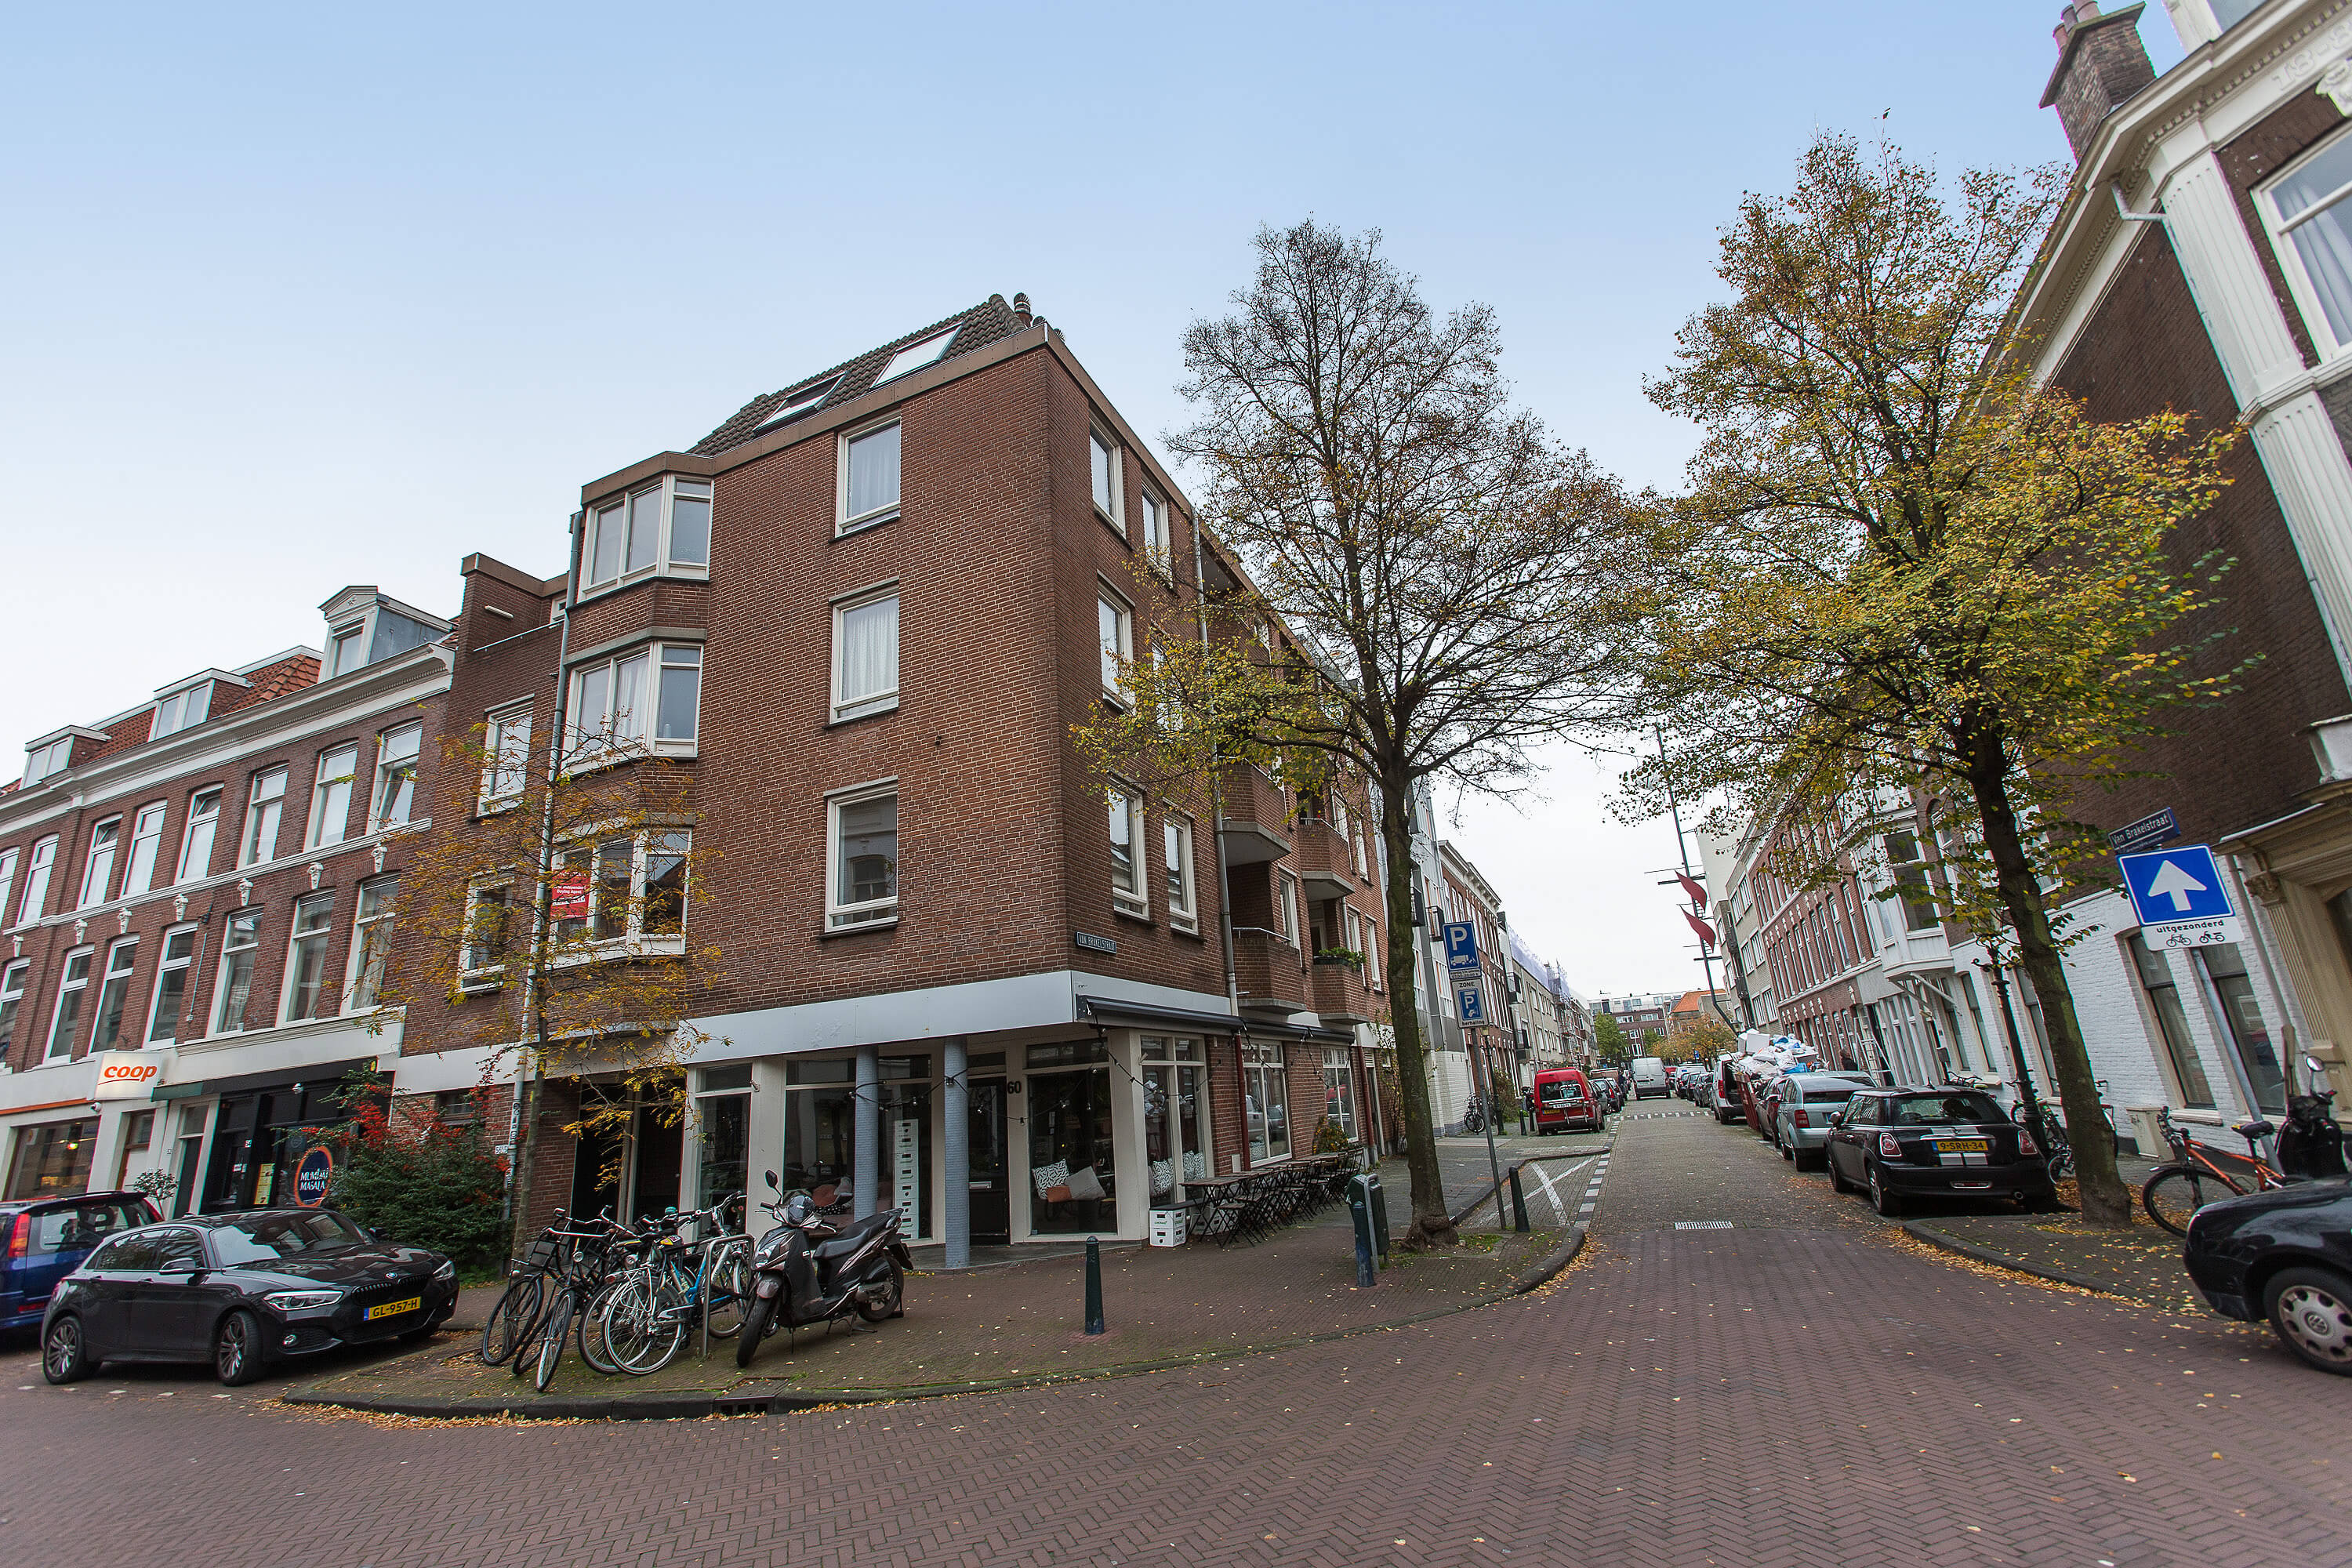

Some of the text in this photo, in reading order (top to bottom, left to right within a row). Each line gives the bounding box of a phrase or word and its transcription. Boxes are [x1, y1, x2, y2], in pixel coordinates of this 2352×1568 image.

[2111, 833, 2125, 845] Van
[2125, 814, 2169, 839] Brakelstraat
[2156, 920, 2224, 933] uitgezonderd
[1079, 934, 1115, 950] VAN BRAKELSTRAAT
[1450, 927, 1468, 951] P
[1465, 996, 1475, 1009] P
[103, 1065, 158, 1082] coop
[1007, 1080, 1022, 1094] 60
[1940, 1142, 1984, 1150] 9-SRH-34
[299, 1180, 326, 1192] MASALA
[373, 1298, 418, 1317] GL-957-H
